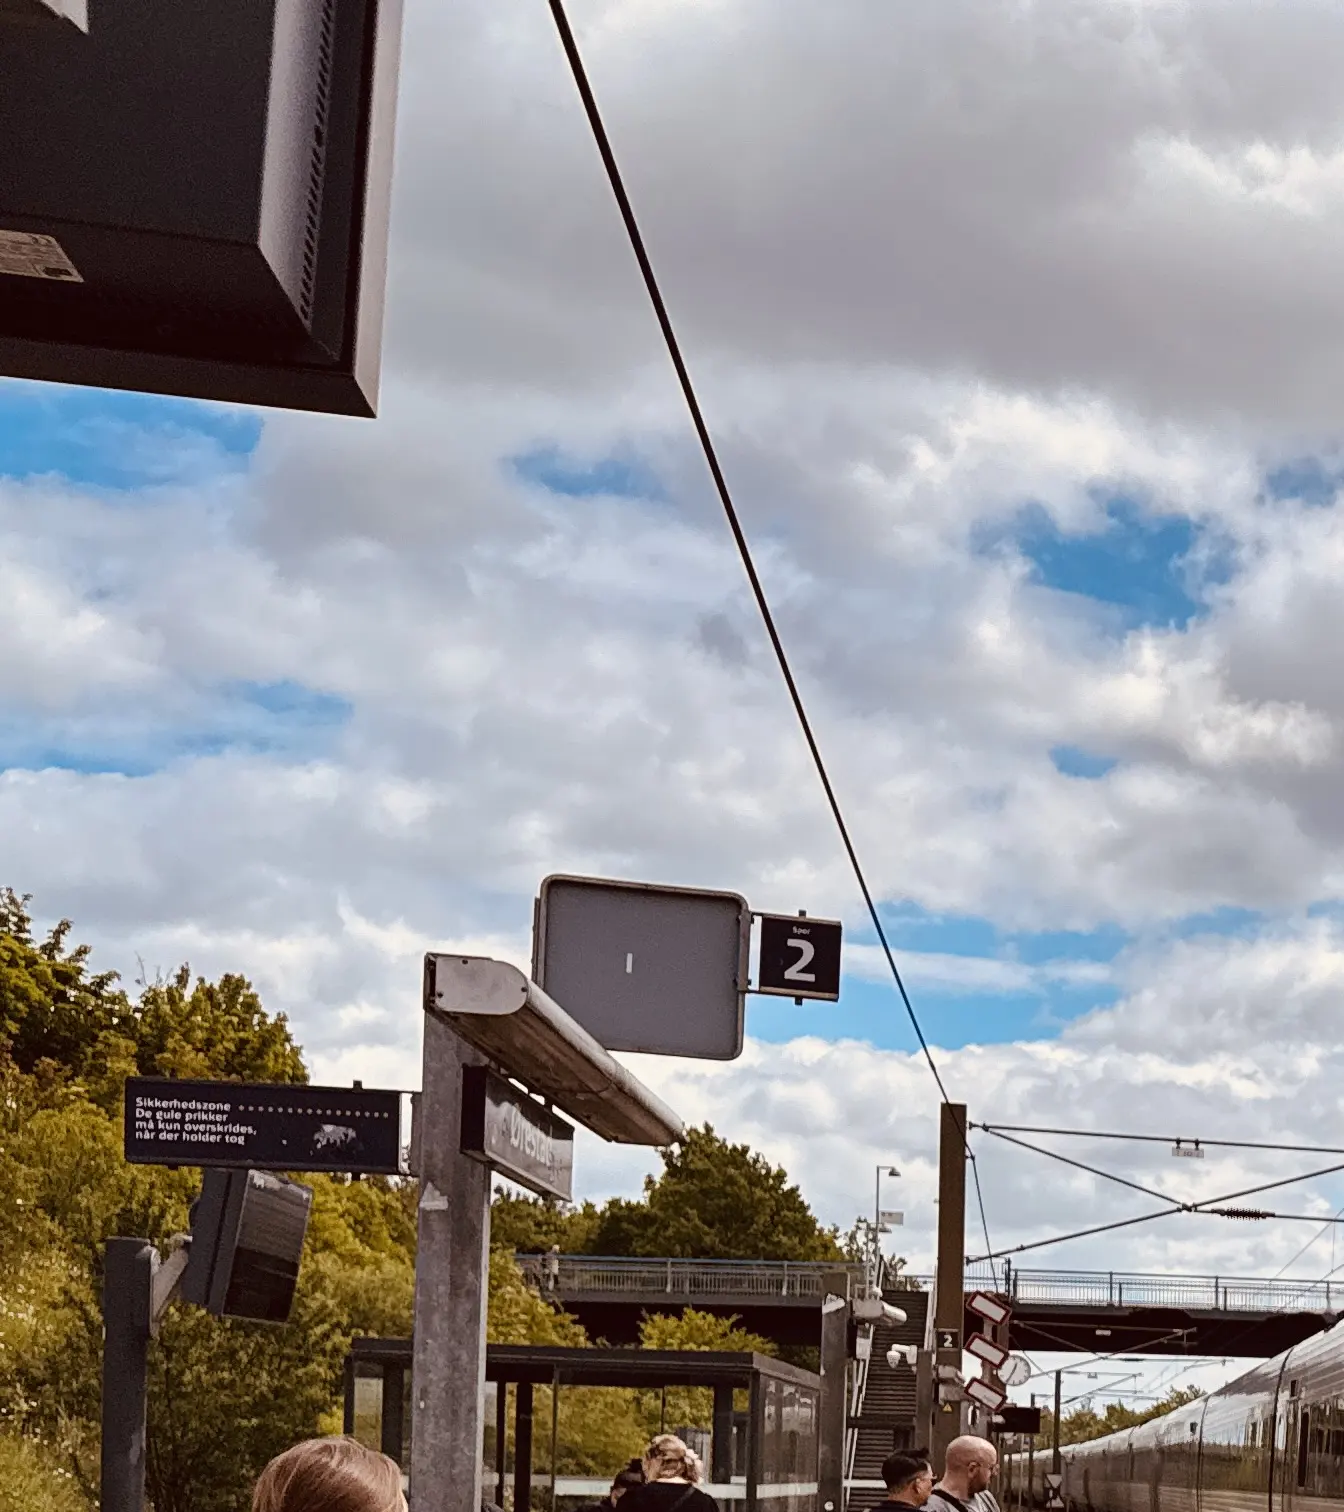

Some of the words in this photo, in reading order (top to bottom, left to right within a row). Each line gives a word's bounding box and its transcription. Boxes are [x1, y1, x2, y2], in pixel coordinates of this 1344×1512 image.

[792, 926, 811, 935] Spor
[784, 938, 815, 983] 2
[135, 1097, 231, 1111] Sikkerhedszone
[135, 1108, 152, 1118] De
[156, 1110, 182, 1120] gule
[185, 1111, 228, 1122] prikker
[135, 1118, 155, 1129] må
[157, 1120, 181, 1130] kun
[135, 1129, 156, 1139] når
[158, 1131, 180, 1141] der
[182, 1132, 222, 1142] holder
[225, 1134, 245, 1145] tog
[943, 1334, 953, 1348] 2
